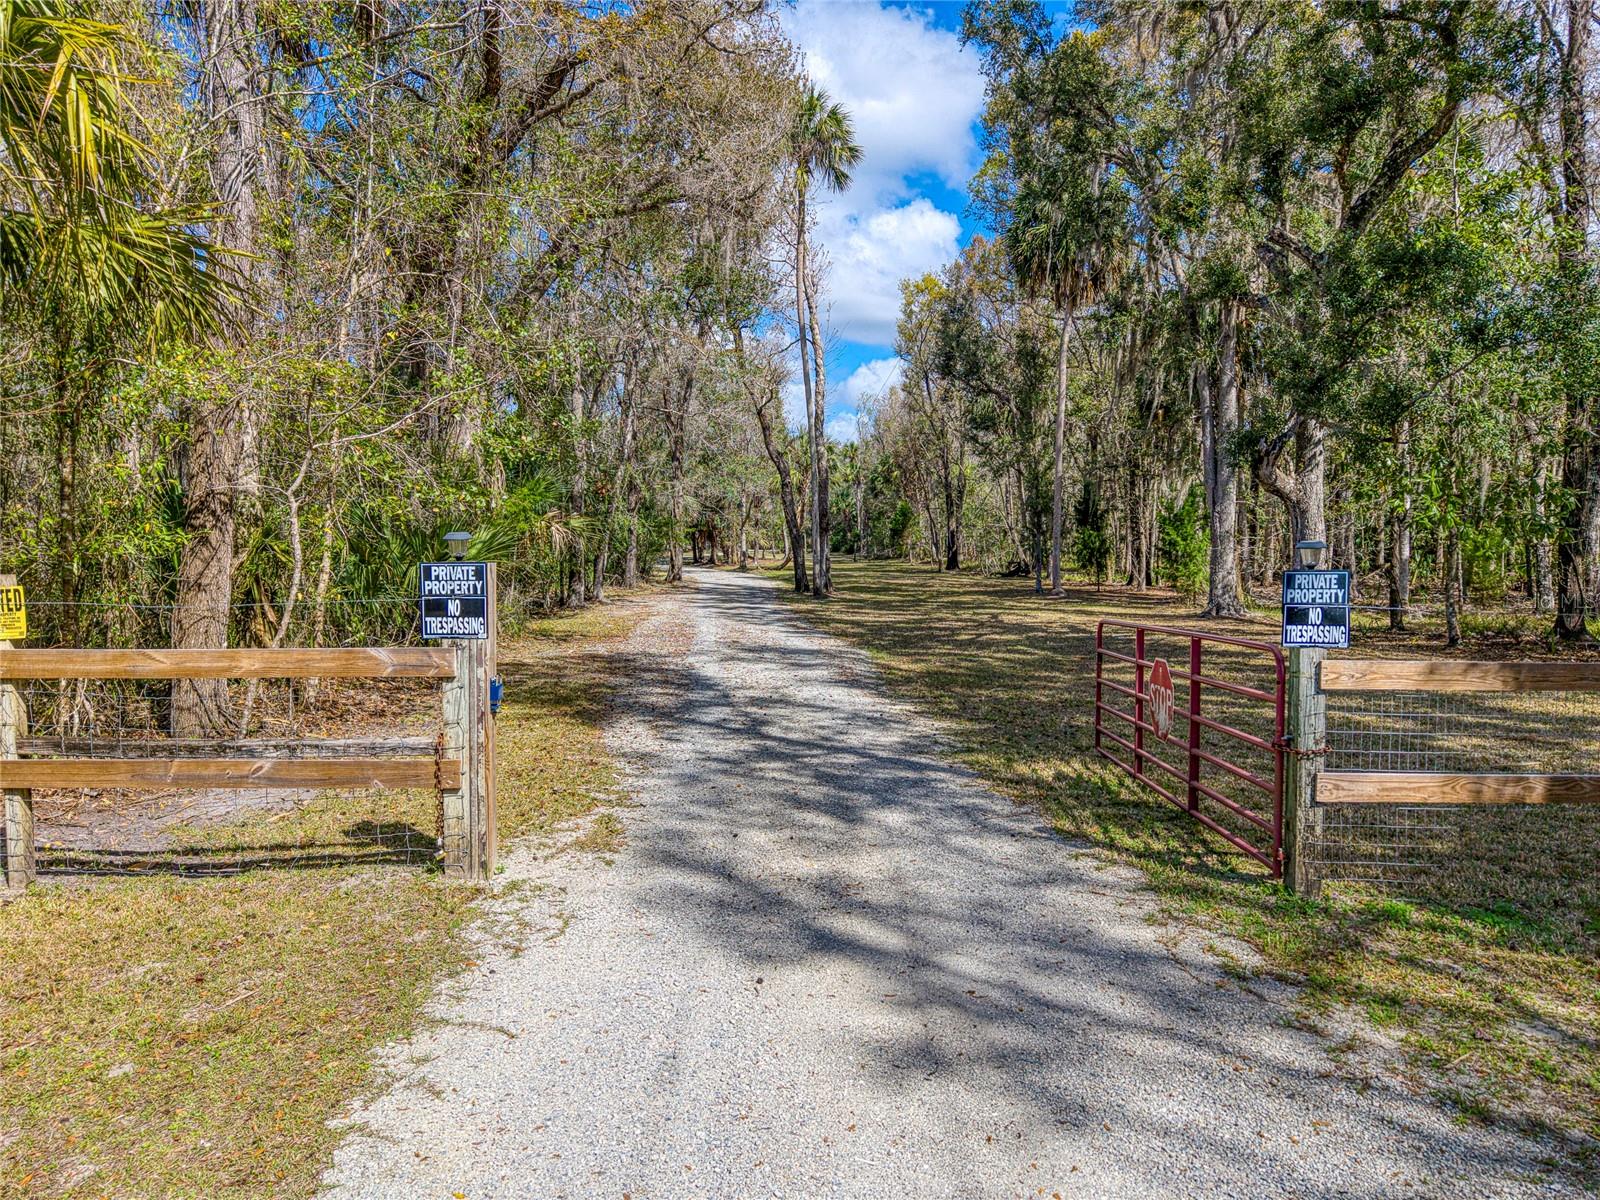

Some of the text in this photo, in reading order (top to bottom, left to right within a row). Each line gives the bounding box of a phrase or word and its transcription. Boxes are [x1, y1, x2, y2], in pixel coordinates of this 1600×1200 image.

[431, 566, 476, 580] PRIVATE
[1295, 574, 1338, 588] PRIVATE
[424, 580, 483, 594] PROPERTY
[1286, 588, 1344, 603] PROPERTY
[447, 599, 460, 616] NO
[1308, 607, 1322, 625] NO
[425, 617, 484, 634] TRESPASSING
[1286, 625, 1346, 643] TRESPASSING
[1150, 682, 1172, 720] STOP
